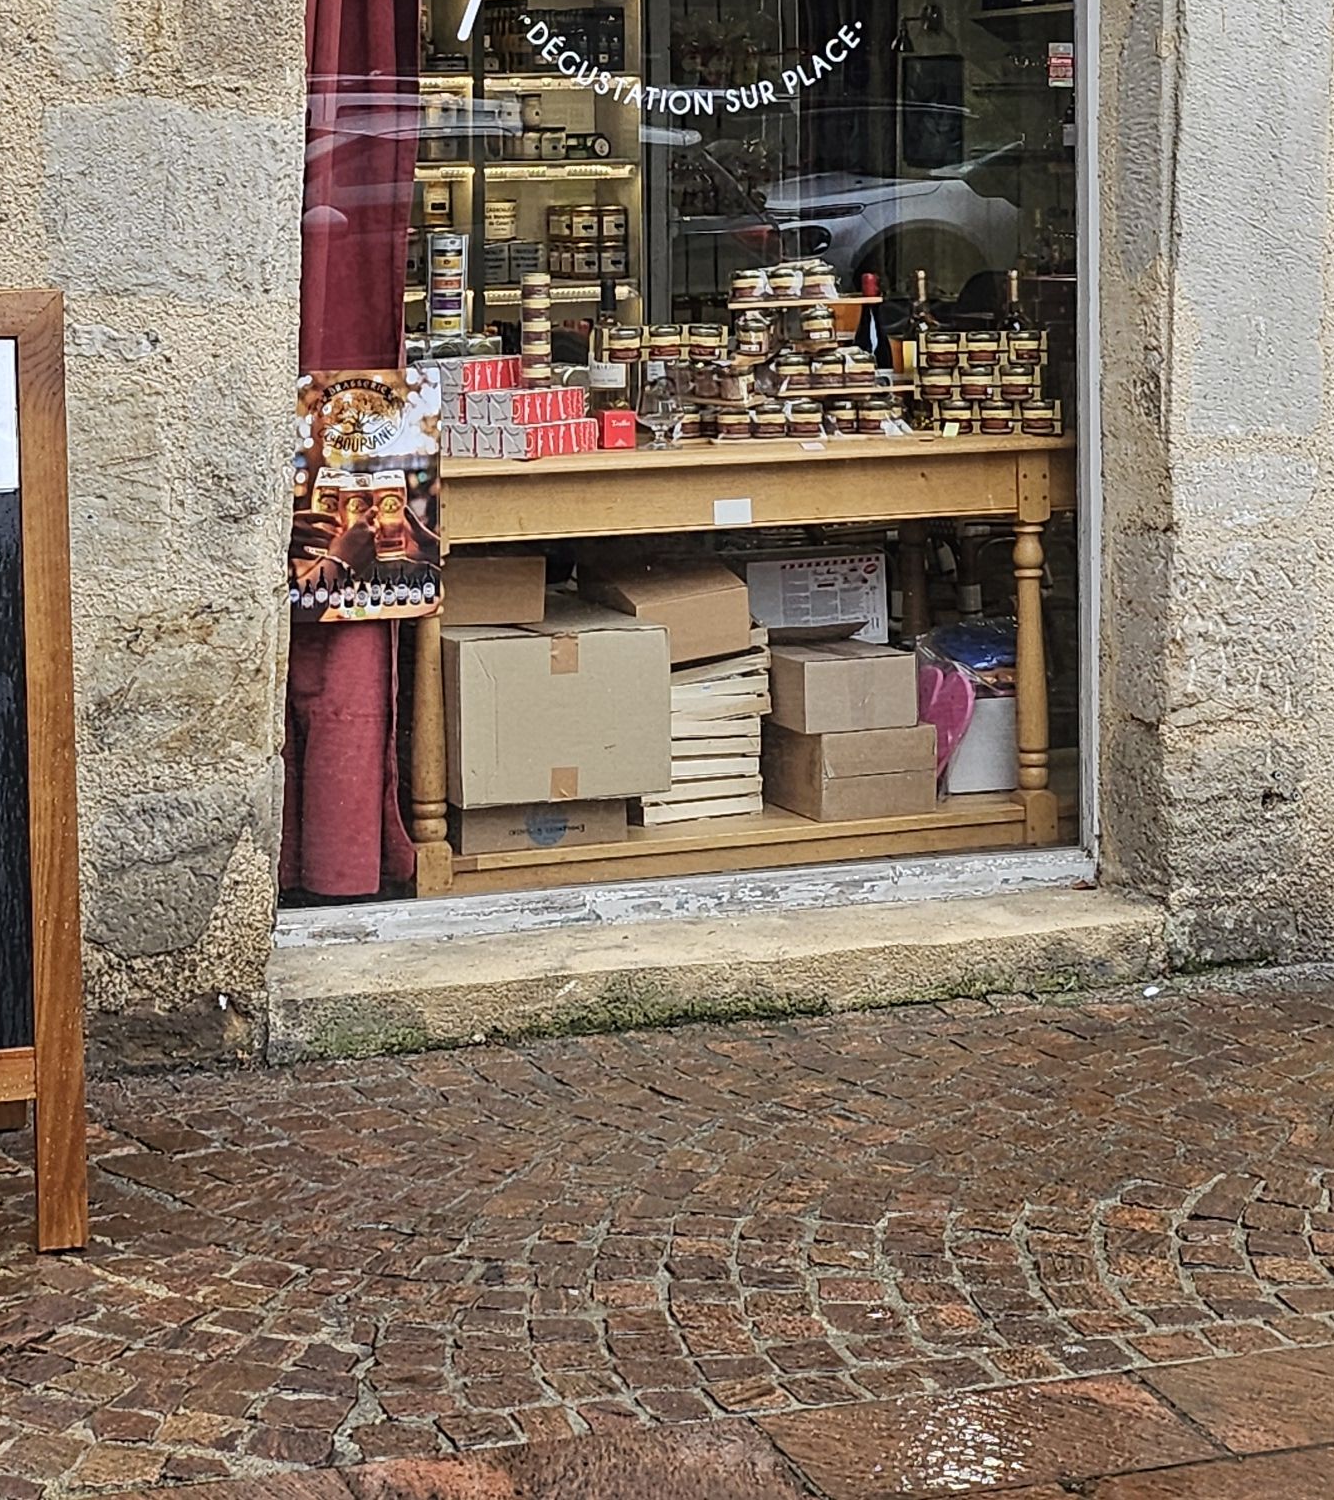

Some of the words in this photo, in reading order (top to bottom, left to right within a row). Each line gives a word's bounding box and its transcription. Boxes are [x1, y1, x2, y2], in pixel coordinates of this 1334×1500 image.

[526, 20, 715, 117] DÉGUSTATION
[724, 79, 777, 114] SUR
[781, 29, 862, 98] PLACE
